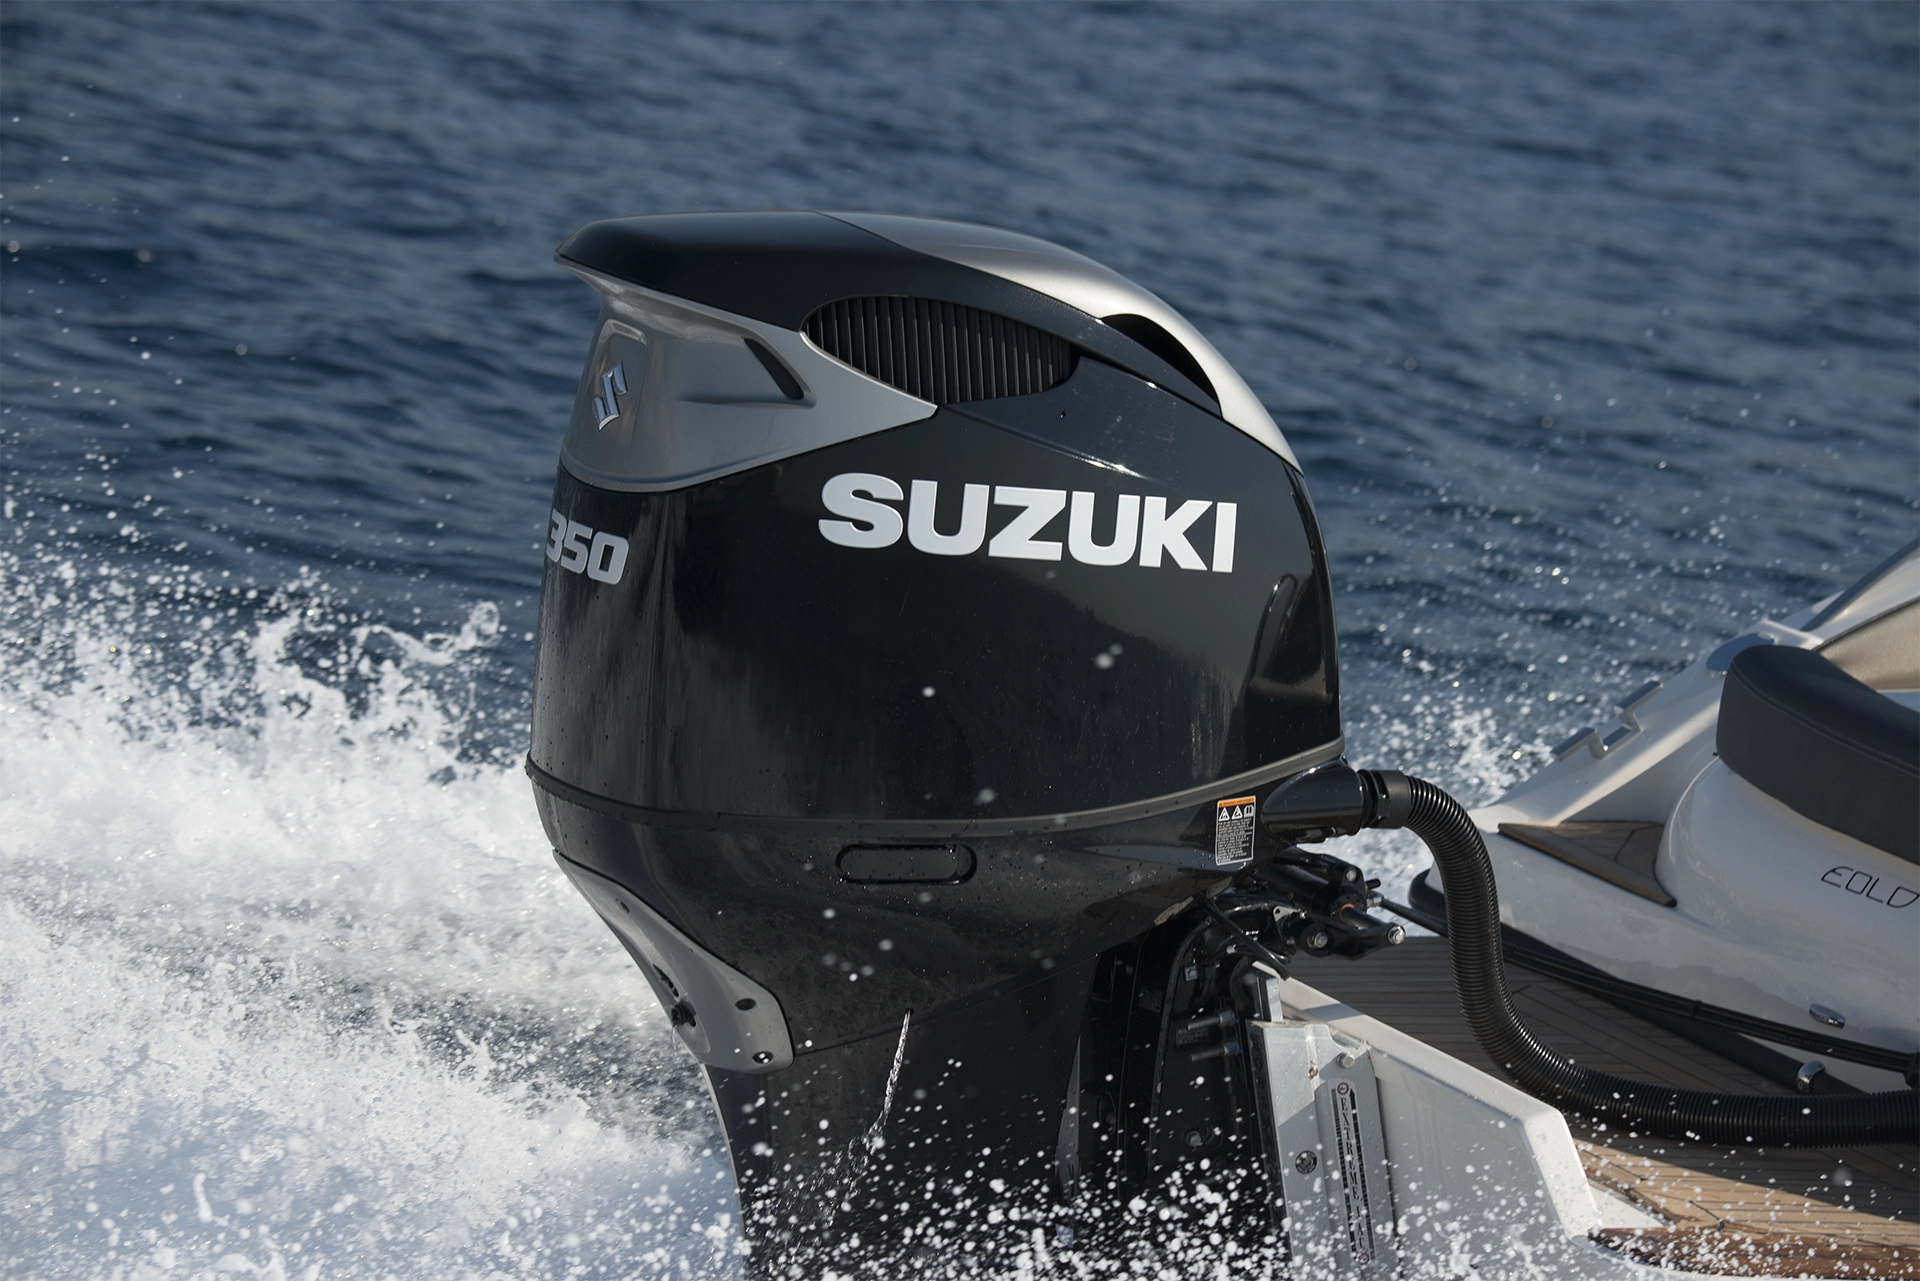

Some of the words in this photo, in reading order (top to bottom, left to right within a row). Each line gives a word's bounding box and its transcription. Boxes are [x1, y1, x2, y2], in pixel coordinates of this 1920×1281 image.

[545, 507, 630, 586] 350
[818, 472, 1238, 573] SUZUKI
[1340, 1097, 1359, 1199] EXTREME
